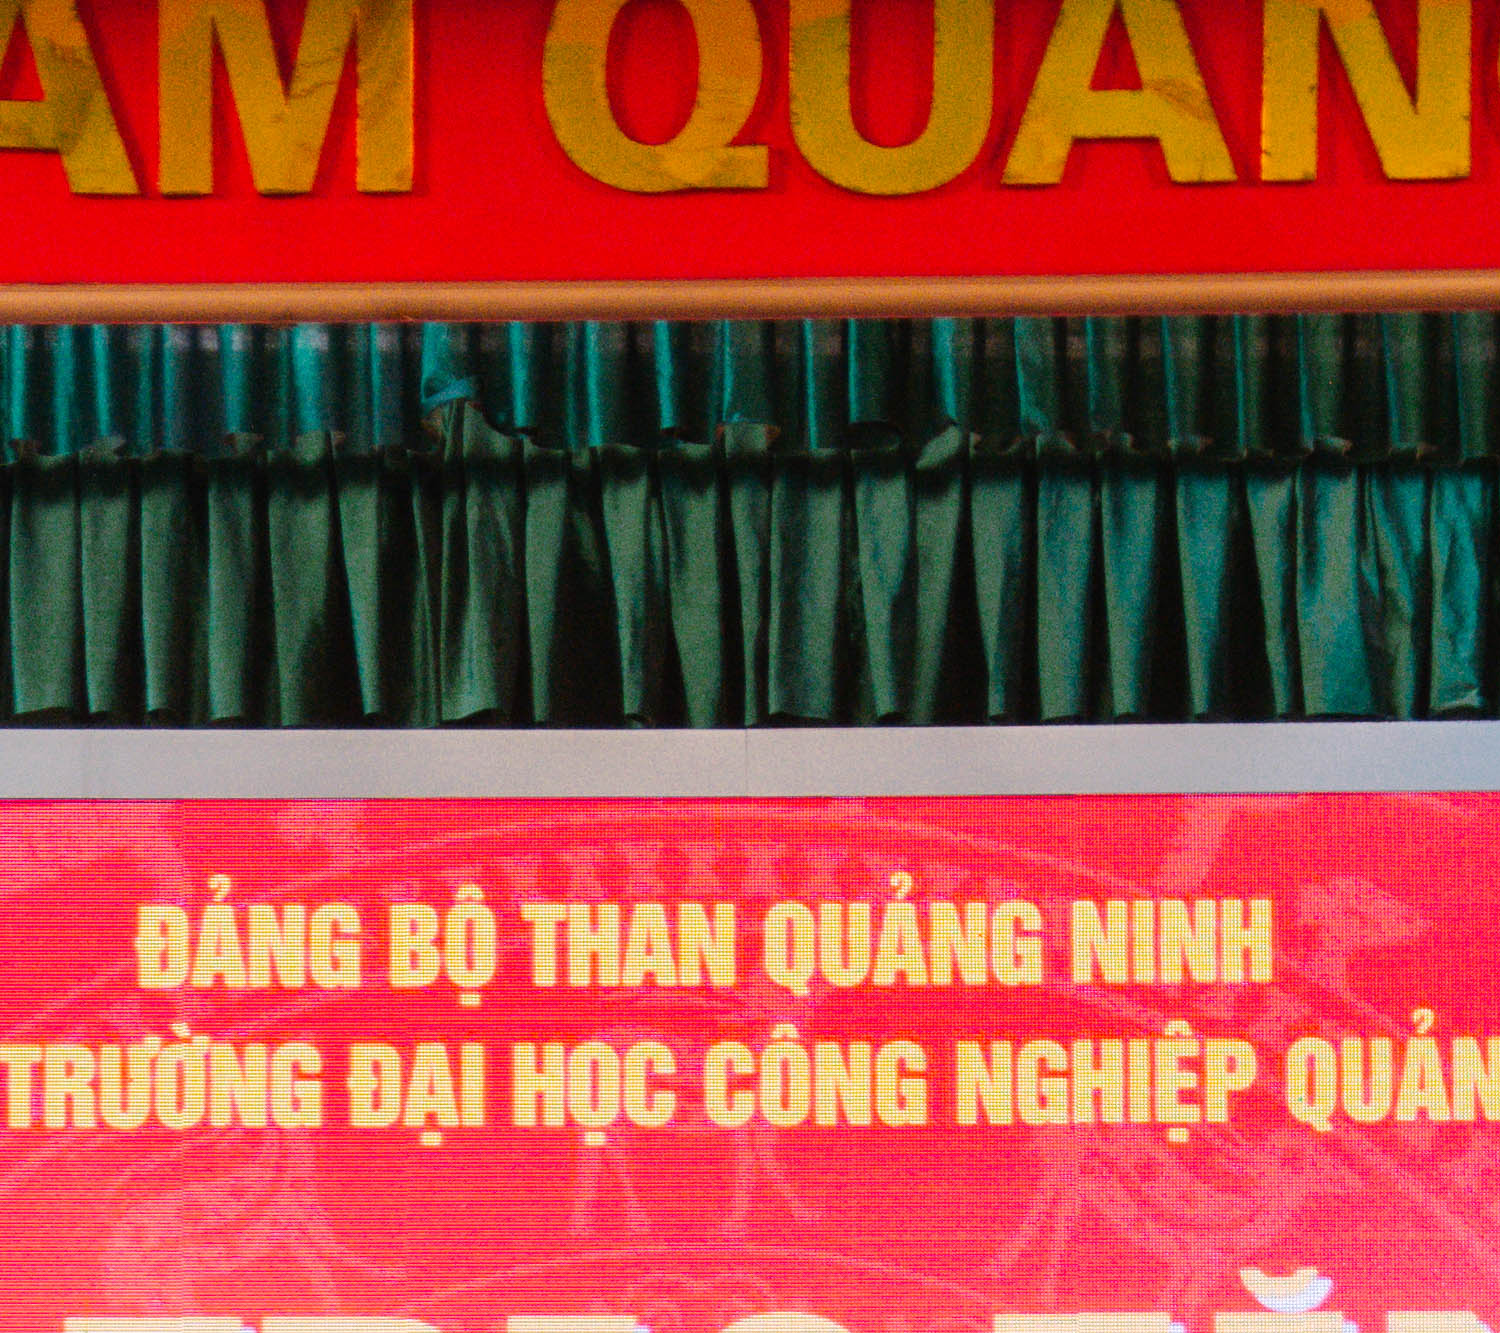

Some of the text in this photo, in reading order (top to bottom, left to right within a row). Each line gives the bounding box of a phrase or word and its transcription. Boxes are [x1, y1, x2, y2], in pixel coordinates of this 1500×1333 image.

[137, 873, 1271, 1005] ĐẢNG BỘ THAN QUẢNG NINH
[349, 1045, 483, 1145] ĐẠI
[515, 1042, 674, 1145] HỌC
[706, 1024, 925, 1126] CÔNG
[958, 1021, 1255, 1141] NGHIỆP
